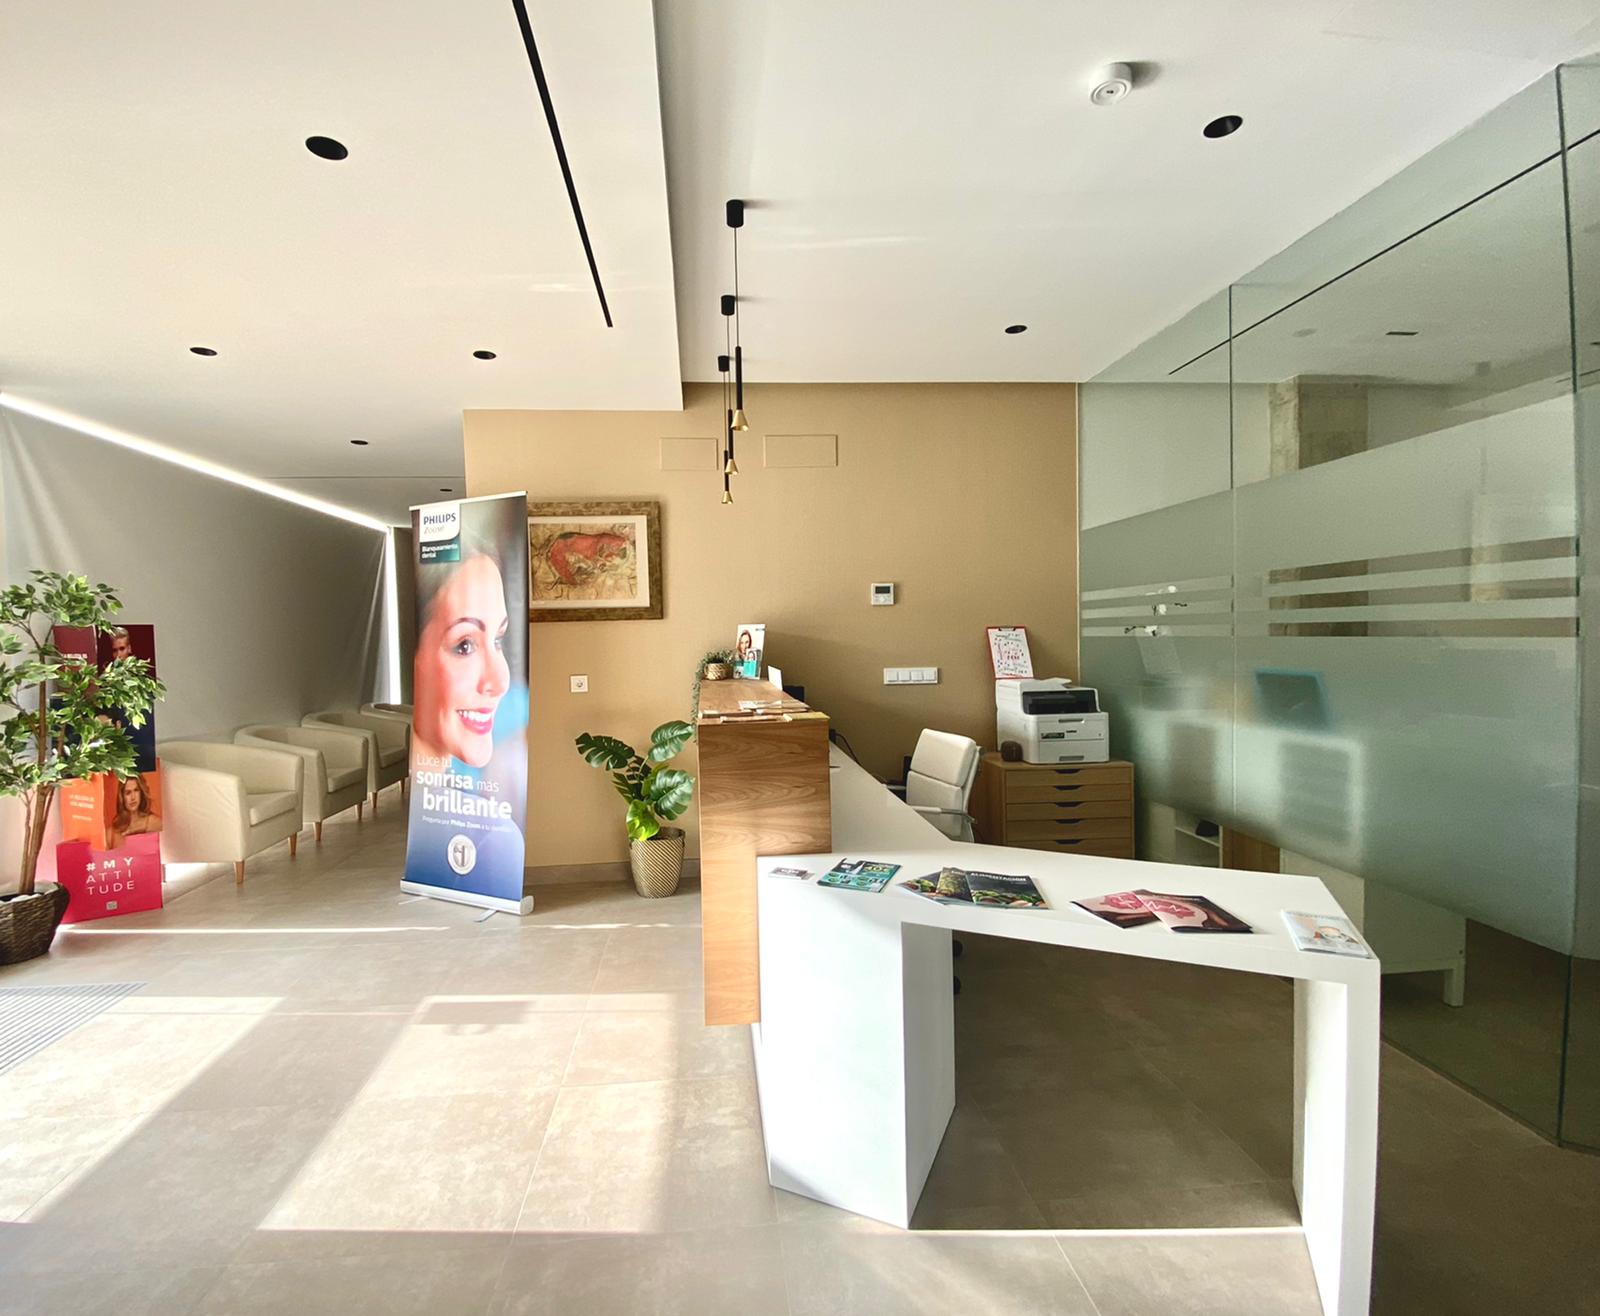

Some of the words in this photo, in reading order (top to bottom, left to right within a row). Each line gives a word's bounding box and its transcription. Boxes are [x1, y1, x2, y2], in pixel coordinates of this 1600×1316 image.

[423, 512, 456, 525] PHILIPS
[416, 753, 440, 767] Luce
[416, 769, 474, 790] sonrisa
[422, 787, 512, 819] brillante
